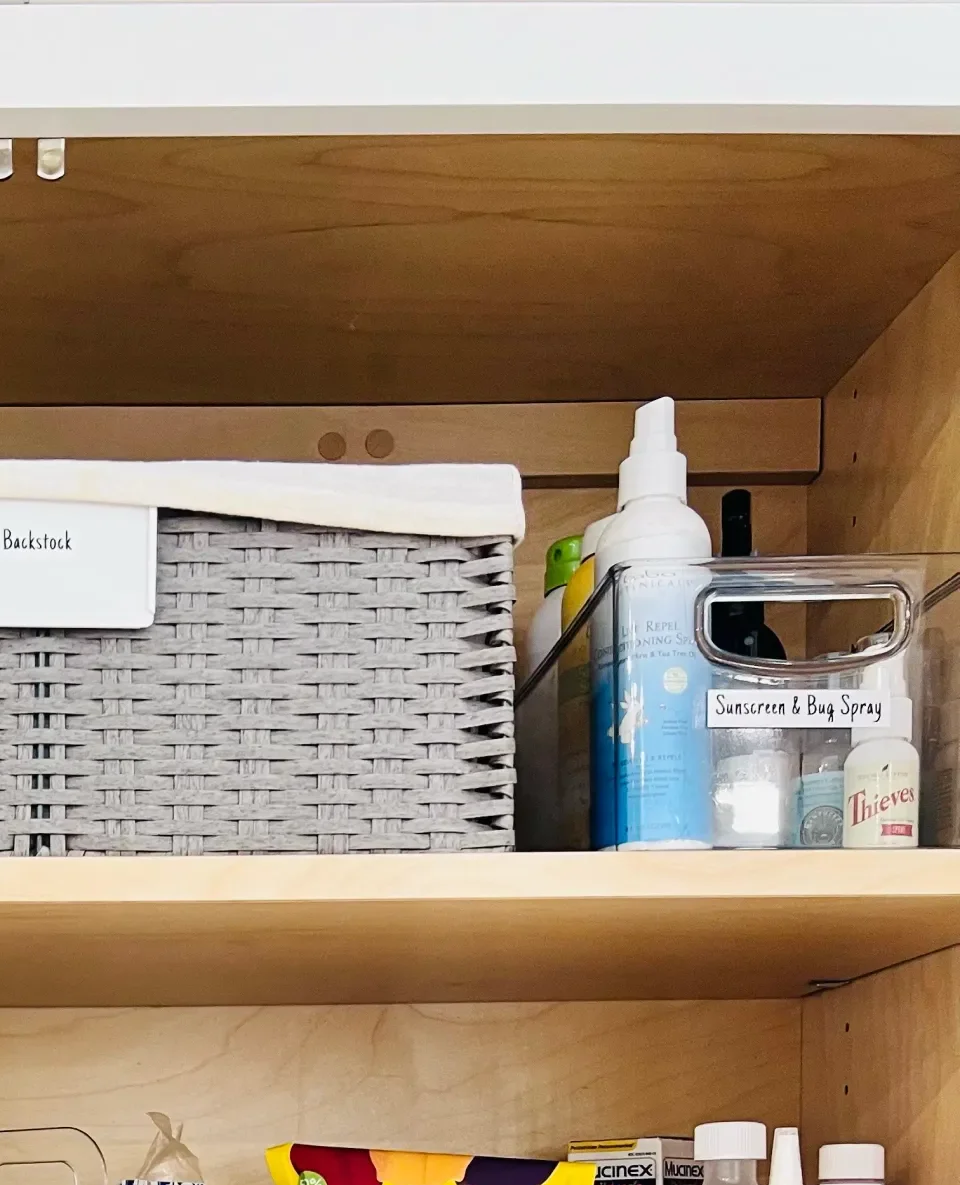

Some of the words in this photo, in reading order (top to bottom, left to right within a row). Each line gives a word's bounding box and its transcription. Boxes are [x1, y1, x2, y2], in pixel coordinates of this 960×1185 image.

[3, 528, 72, 550] Backstock
[715, 694, 786, 716] Sunscreen
[792, 695, 801, 715] &
[807, 695, 835, 722] Bug
[840, 694, 883, 723] Spray
[847, 787, 915, 827] Thieves
